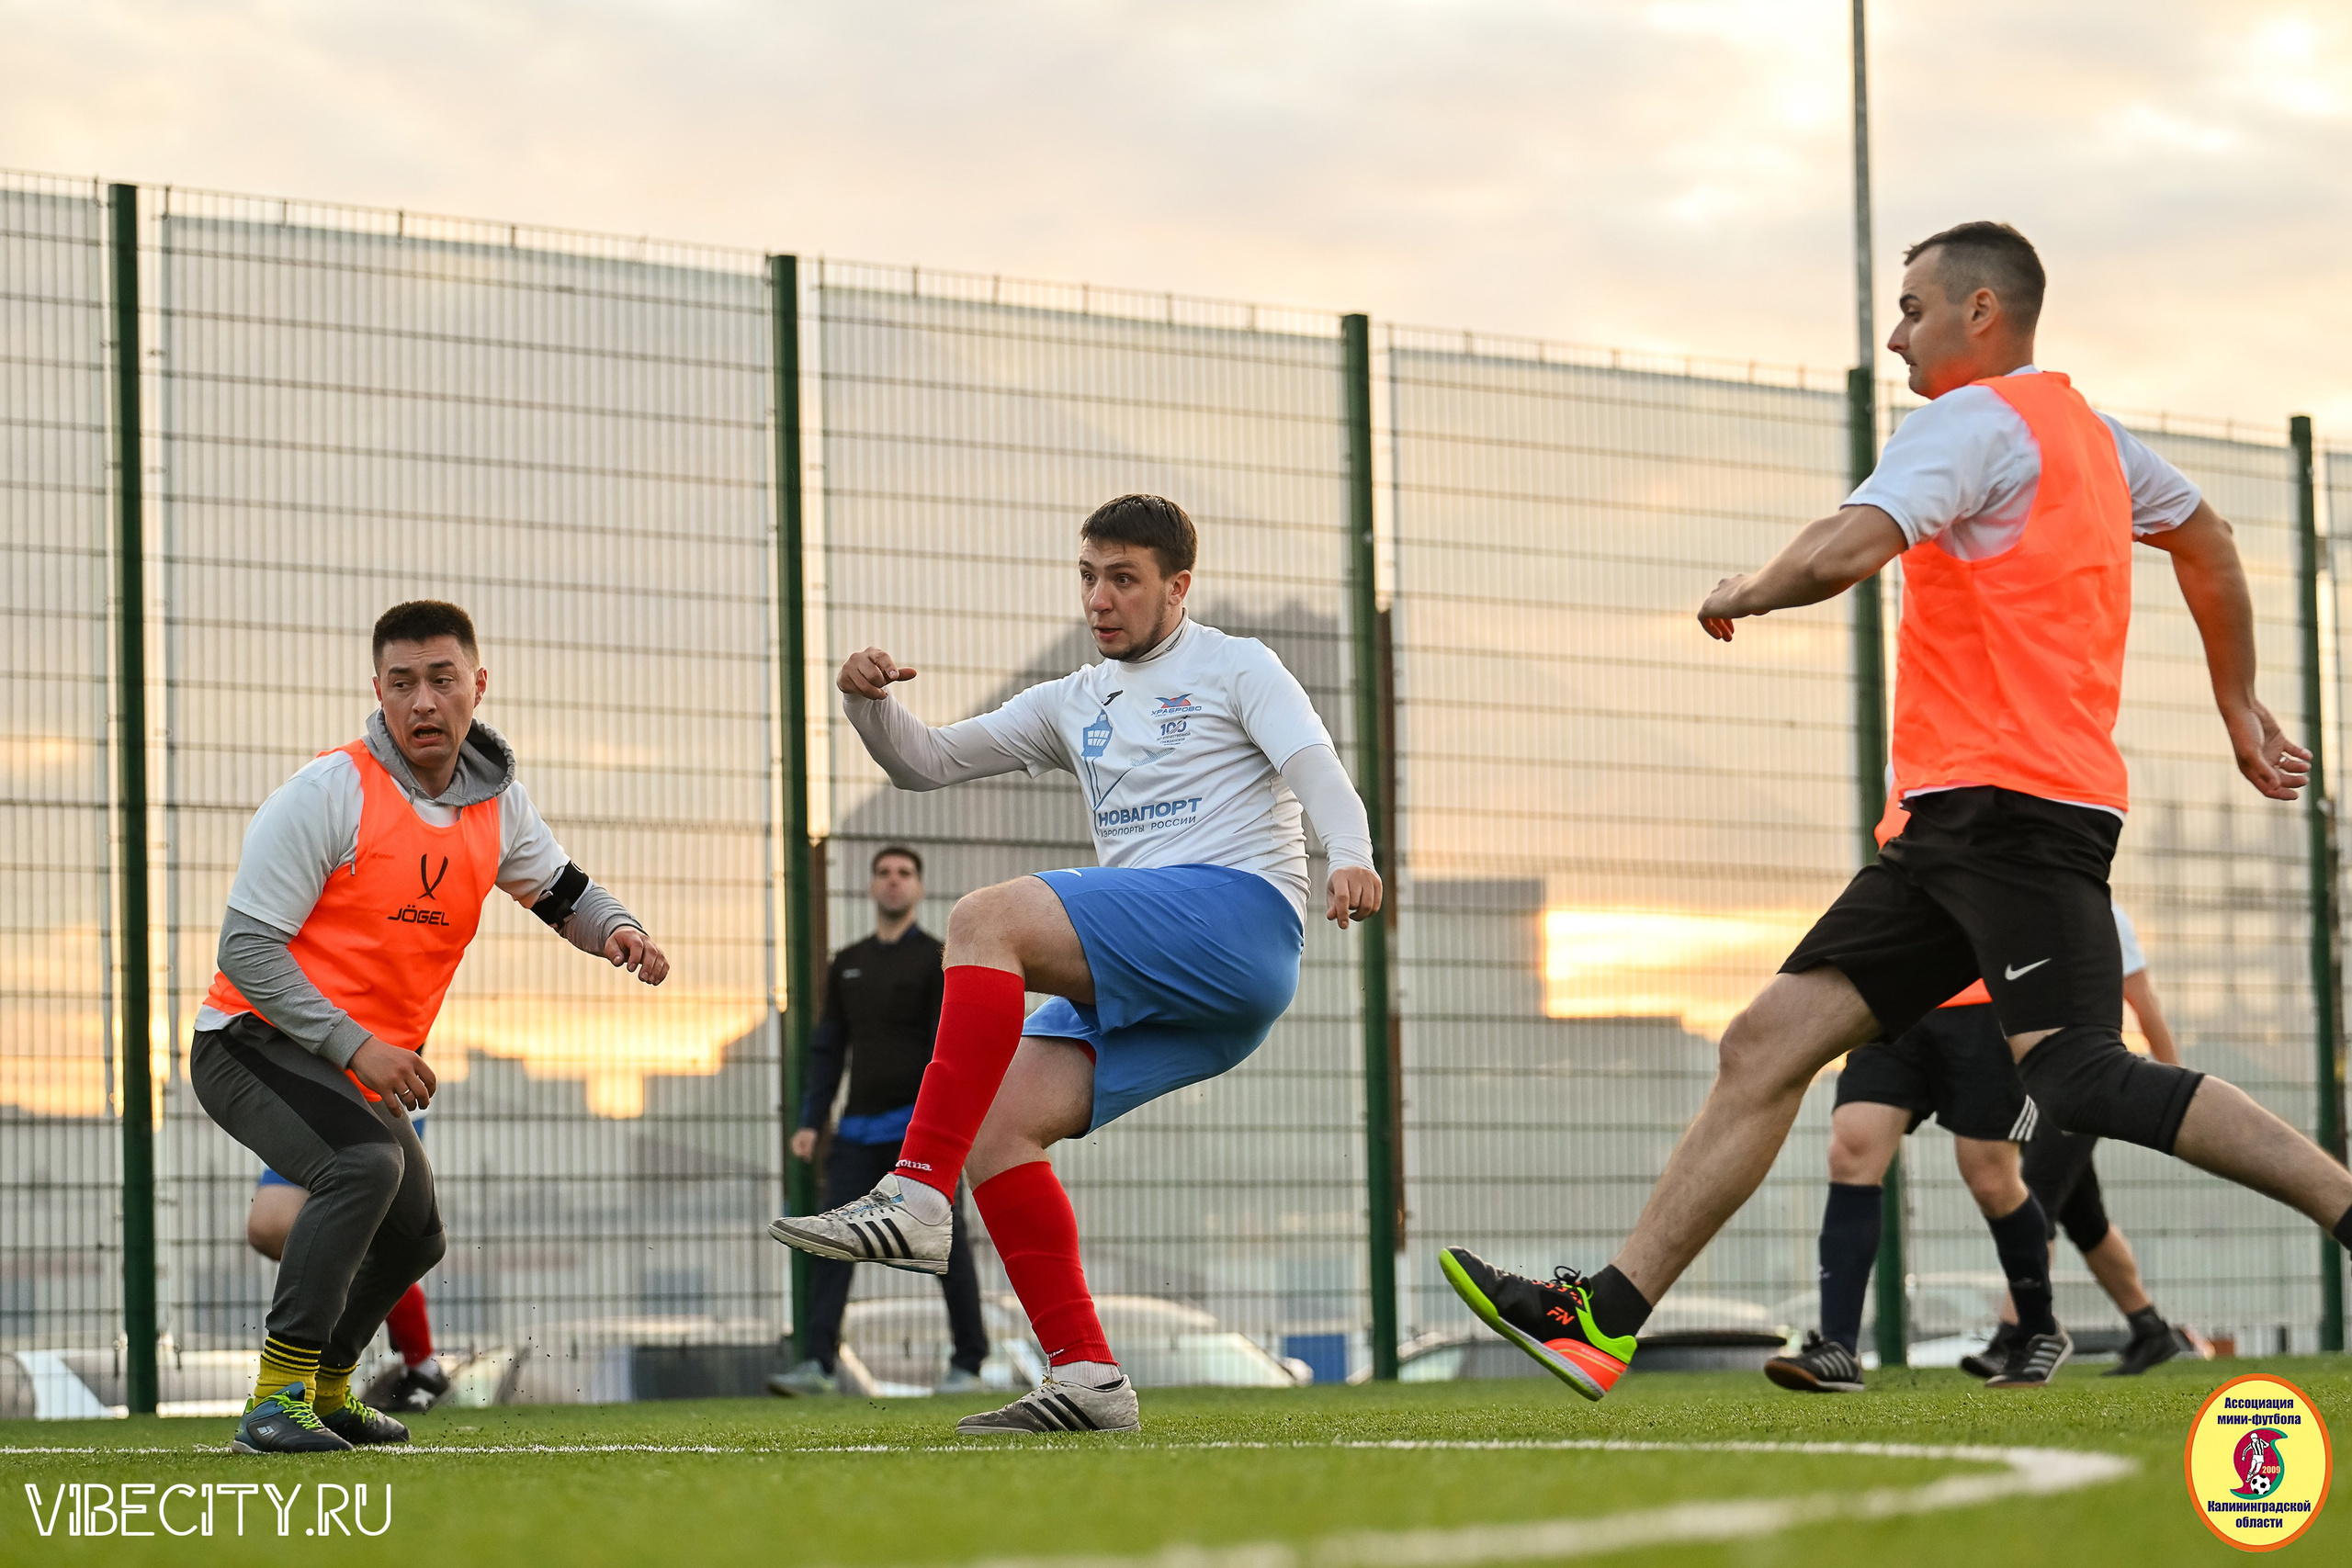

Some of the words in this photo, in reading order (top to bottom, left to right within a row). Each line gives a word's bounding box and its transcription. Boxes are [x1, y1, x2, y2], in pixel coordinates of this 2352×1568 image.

[1160, 719, 1187, 736] 100
[1098, 796, 1203, 827] НОВАПОРТ
[1150, 815, 1196, 830] РОССИИ
[387, 904, 449, 926] JÖGEL
